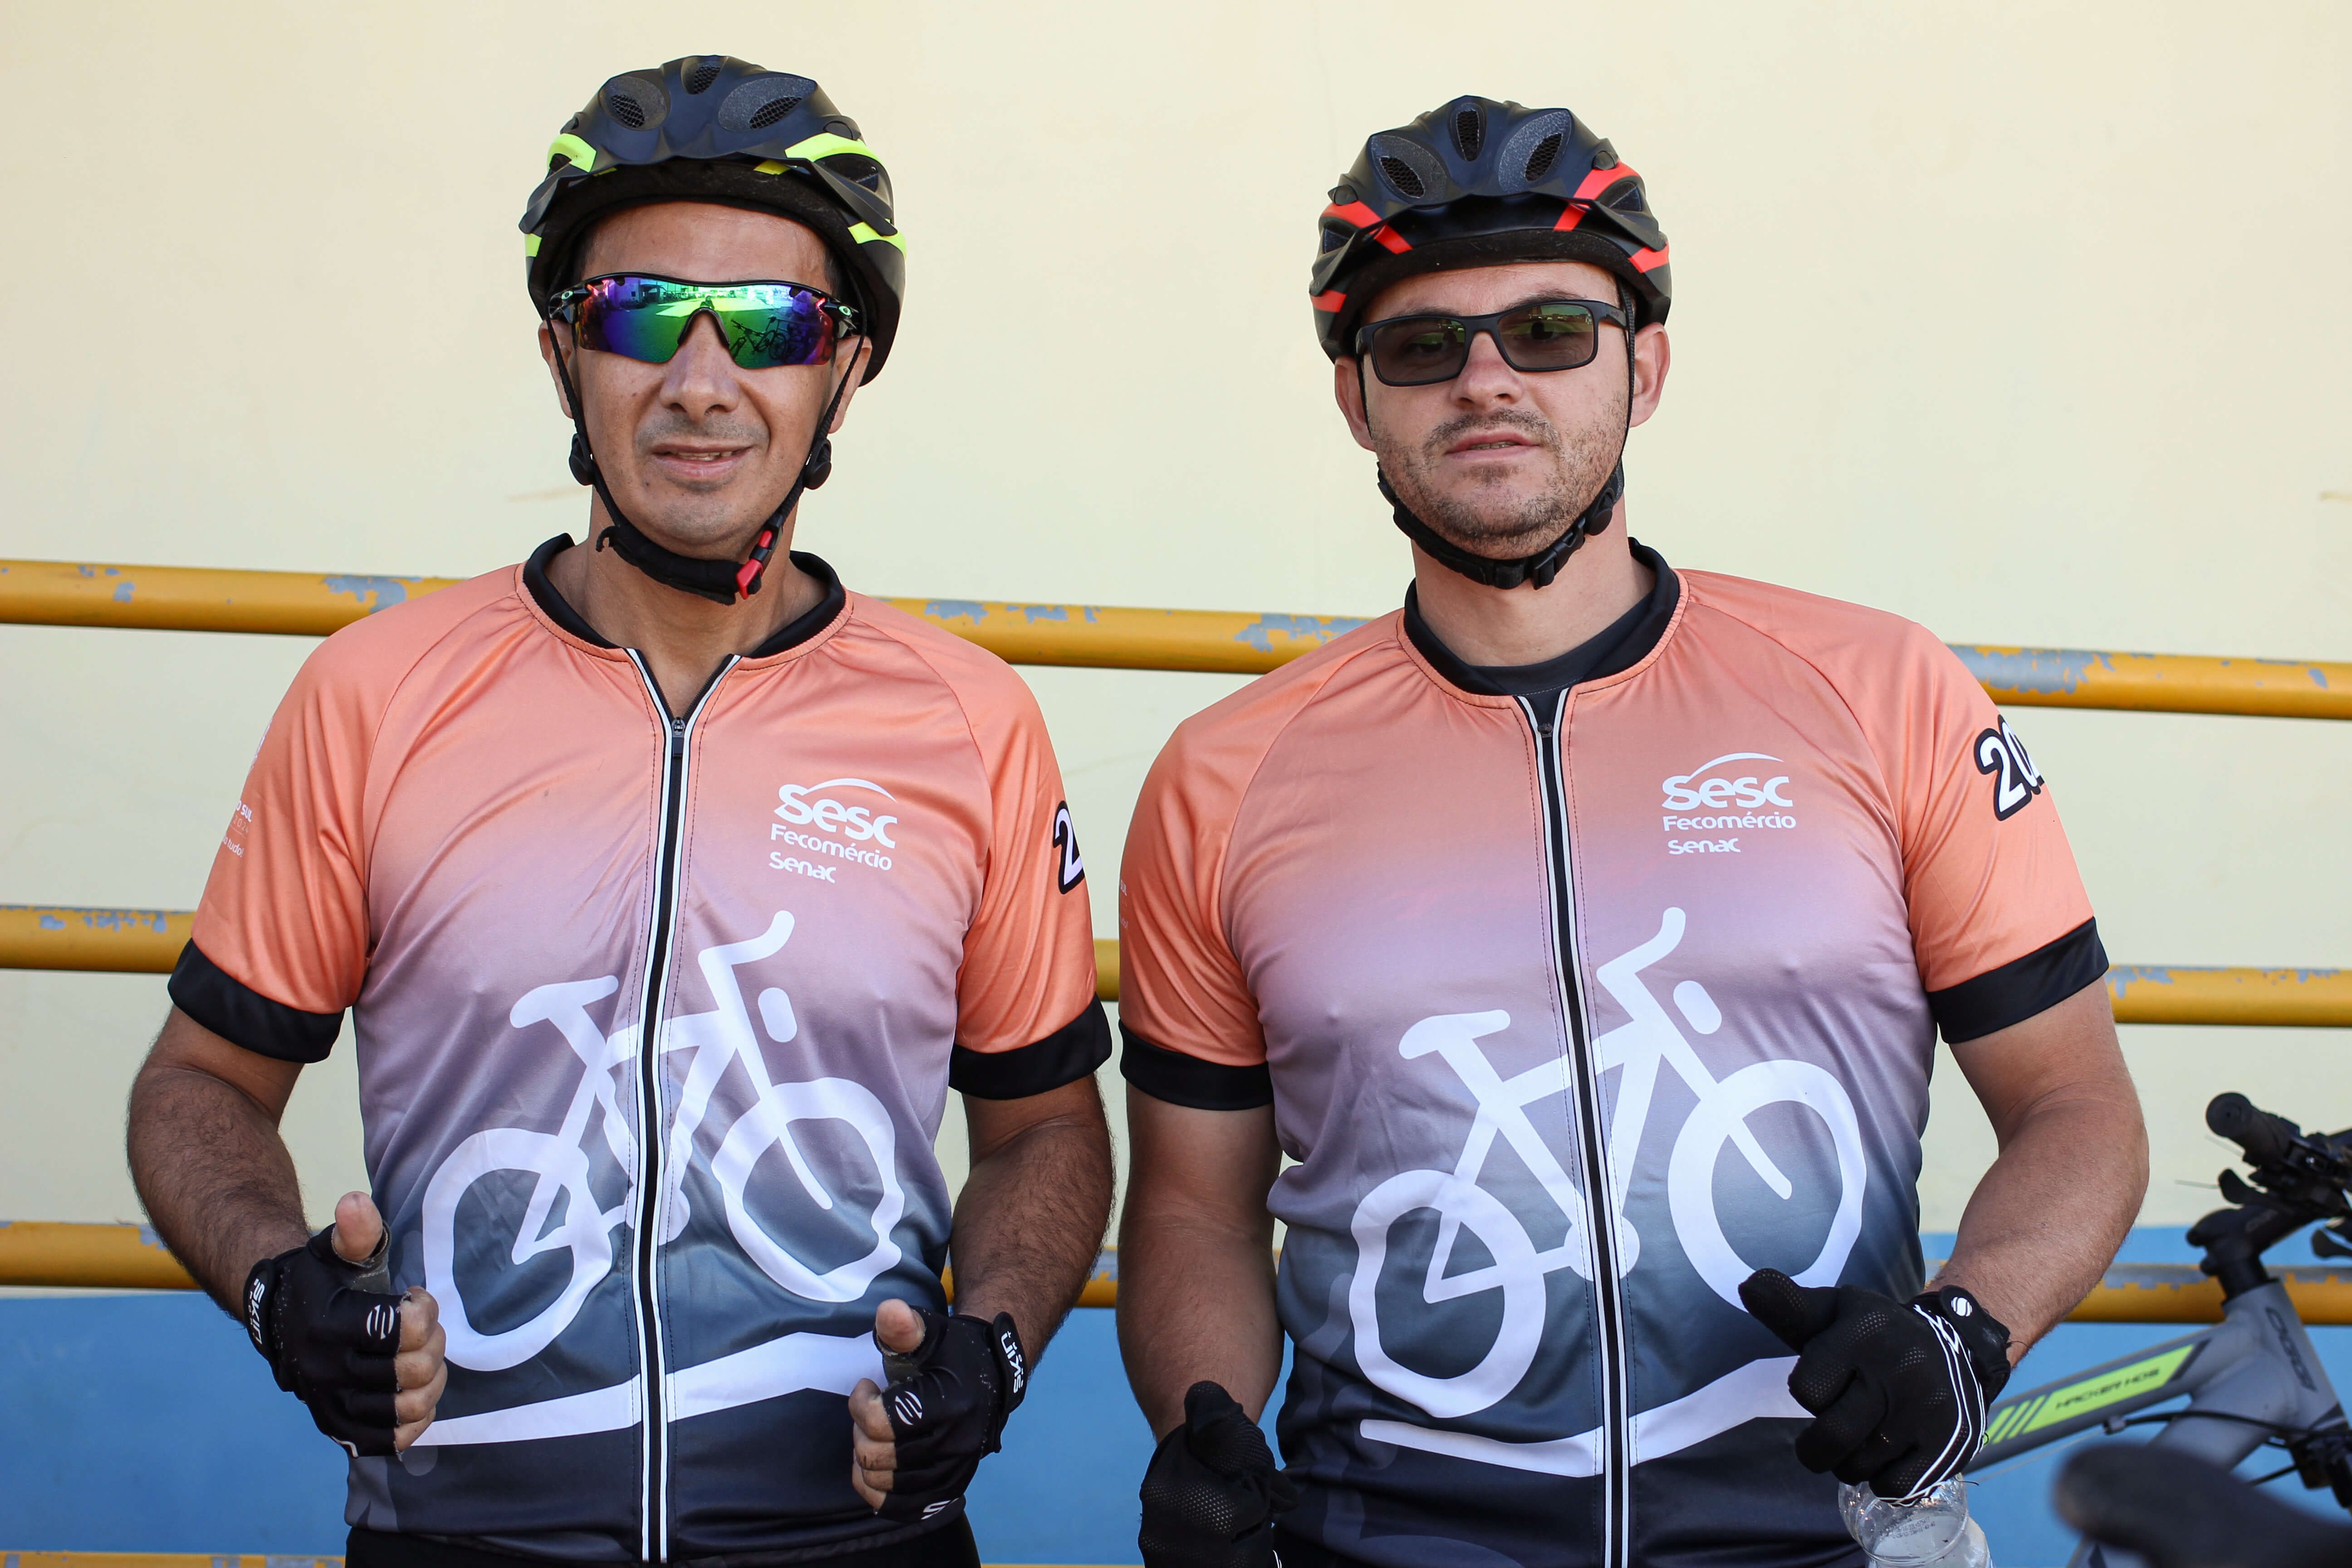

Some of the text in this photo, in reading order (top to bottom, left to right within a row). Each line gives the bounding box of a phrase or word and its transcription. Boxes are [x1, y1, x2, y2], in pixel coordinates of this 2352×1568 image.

[1974, 714, 2044, 821] 20
[240, 804, 253, 823] SUL
[1663, 811, 1797, 831] Fecomércio
[770, 823, 892, 871] Fecomércio
[1668, 838, 1741, 855] Senac
[769, 851, 837, 883] Senac
